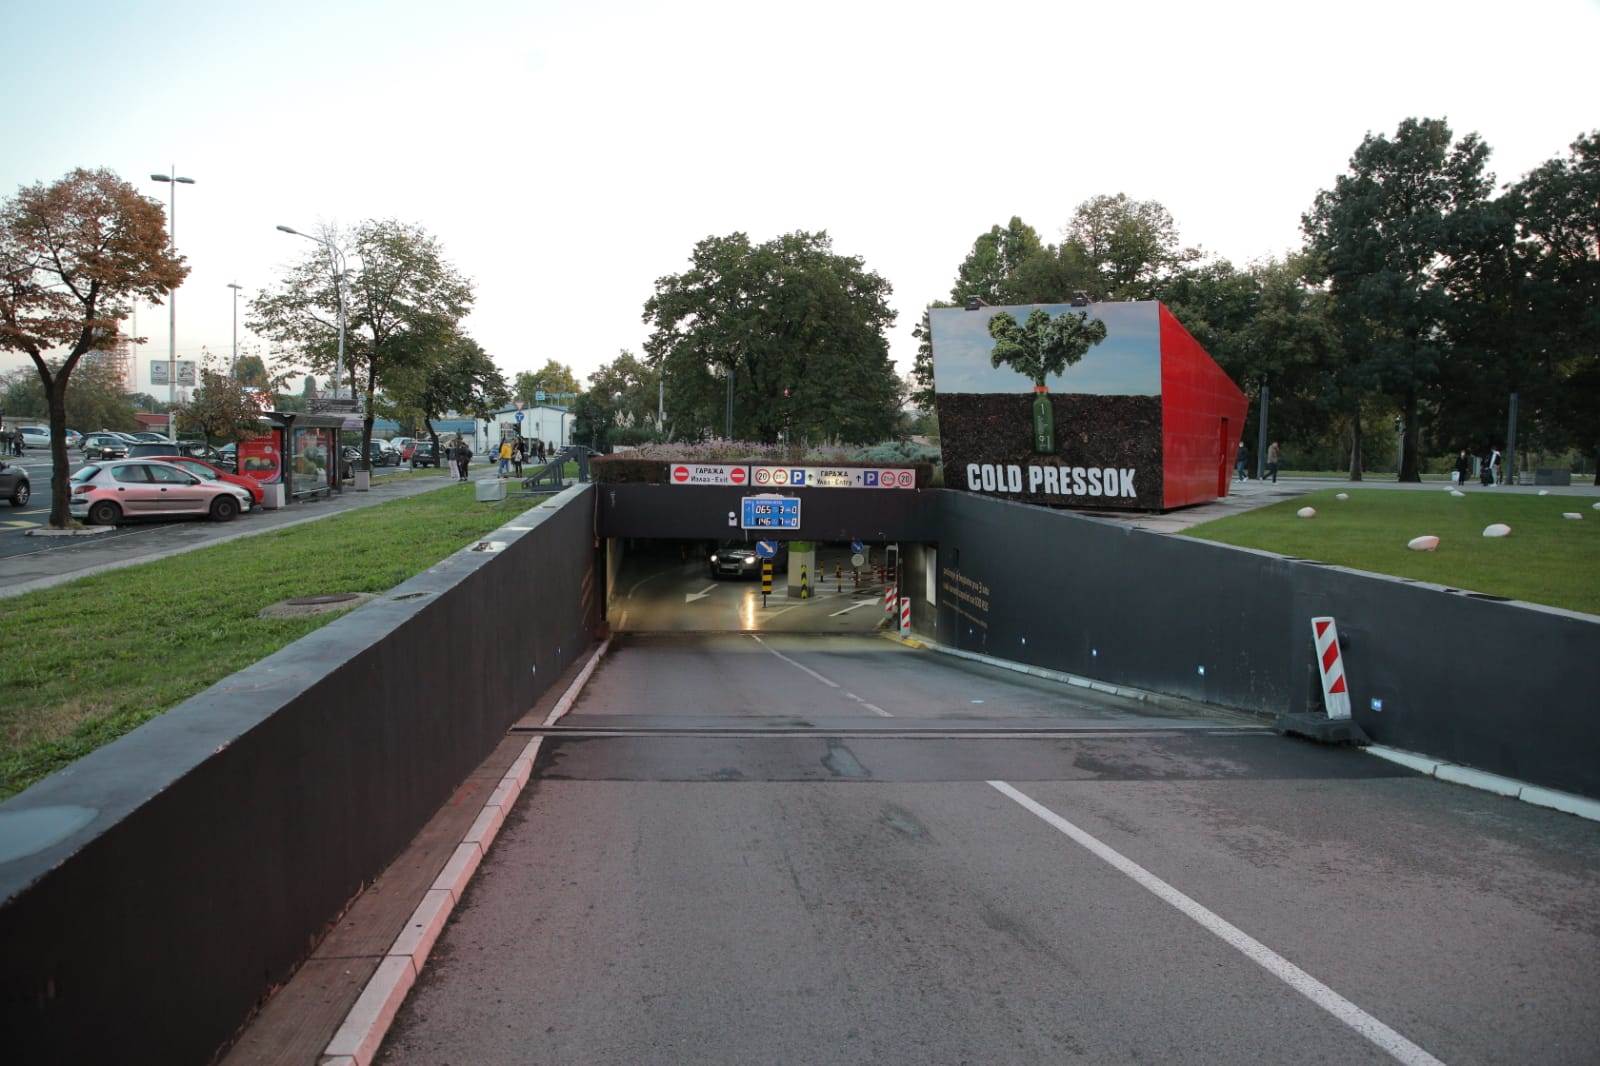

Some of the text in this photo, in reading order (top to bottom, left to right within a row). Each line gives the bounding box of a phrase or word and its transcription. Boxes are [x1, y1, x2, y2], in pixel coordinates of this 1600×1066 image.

[695, 467, 724, 475] ГАРАЖА
[820, 470, 849, 478] ГАРАЖА
[758, 472, 767, 481] 20
[793, 471, 803, 483] P
[866, 472, 876, 484] P
[901, 474, 910, 483] 20
[966, 463, 1137, 498] COLD PRESSOK
[755, 505, 771, 514] 065
